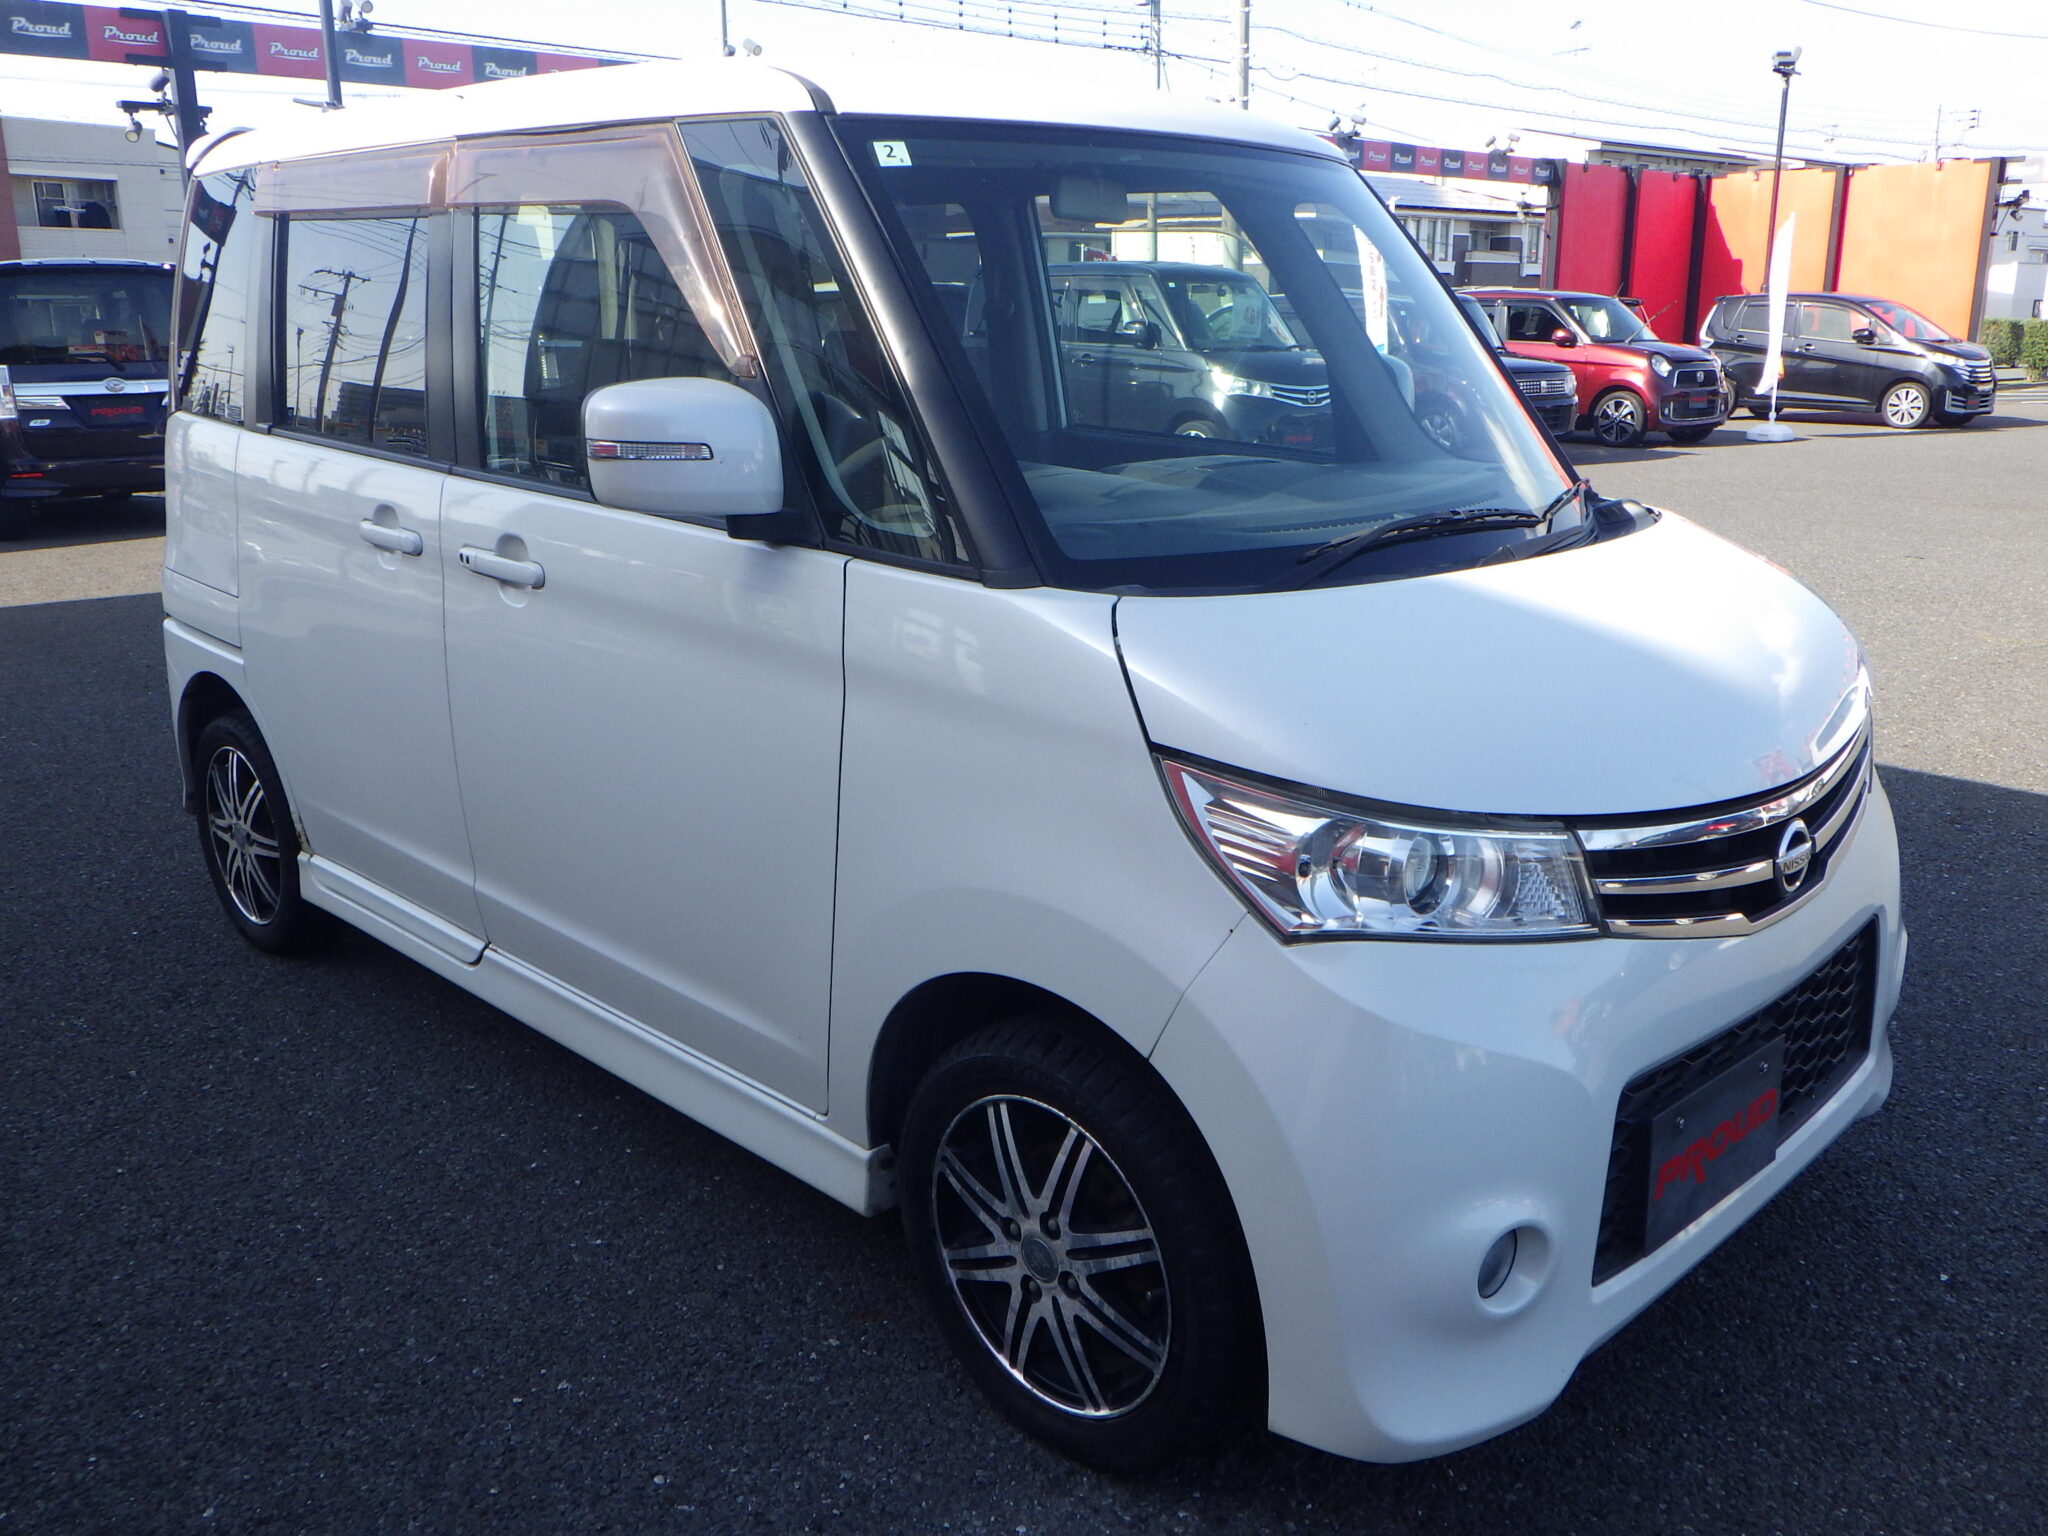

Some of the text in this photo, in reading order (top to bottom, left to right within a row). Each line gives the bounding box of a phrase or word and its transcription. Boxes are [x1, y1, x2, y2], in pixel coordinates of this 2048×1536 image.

[9, 17, 72, 37] Proud
[103, 26, 159, 45] Proud
[190, 34, 243, 53] Proud
[270, 43, 319, 60] Proud
[345, 49, 393, 67] Proud
[417, 57, 462, 73] Proud
[484, 63, 527, 78] Proud
[883, 144, 897, 158] 2
[91, 406, 145, 418] PROUD
[1653, 1088, 1777, 1200] PROUD
